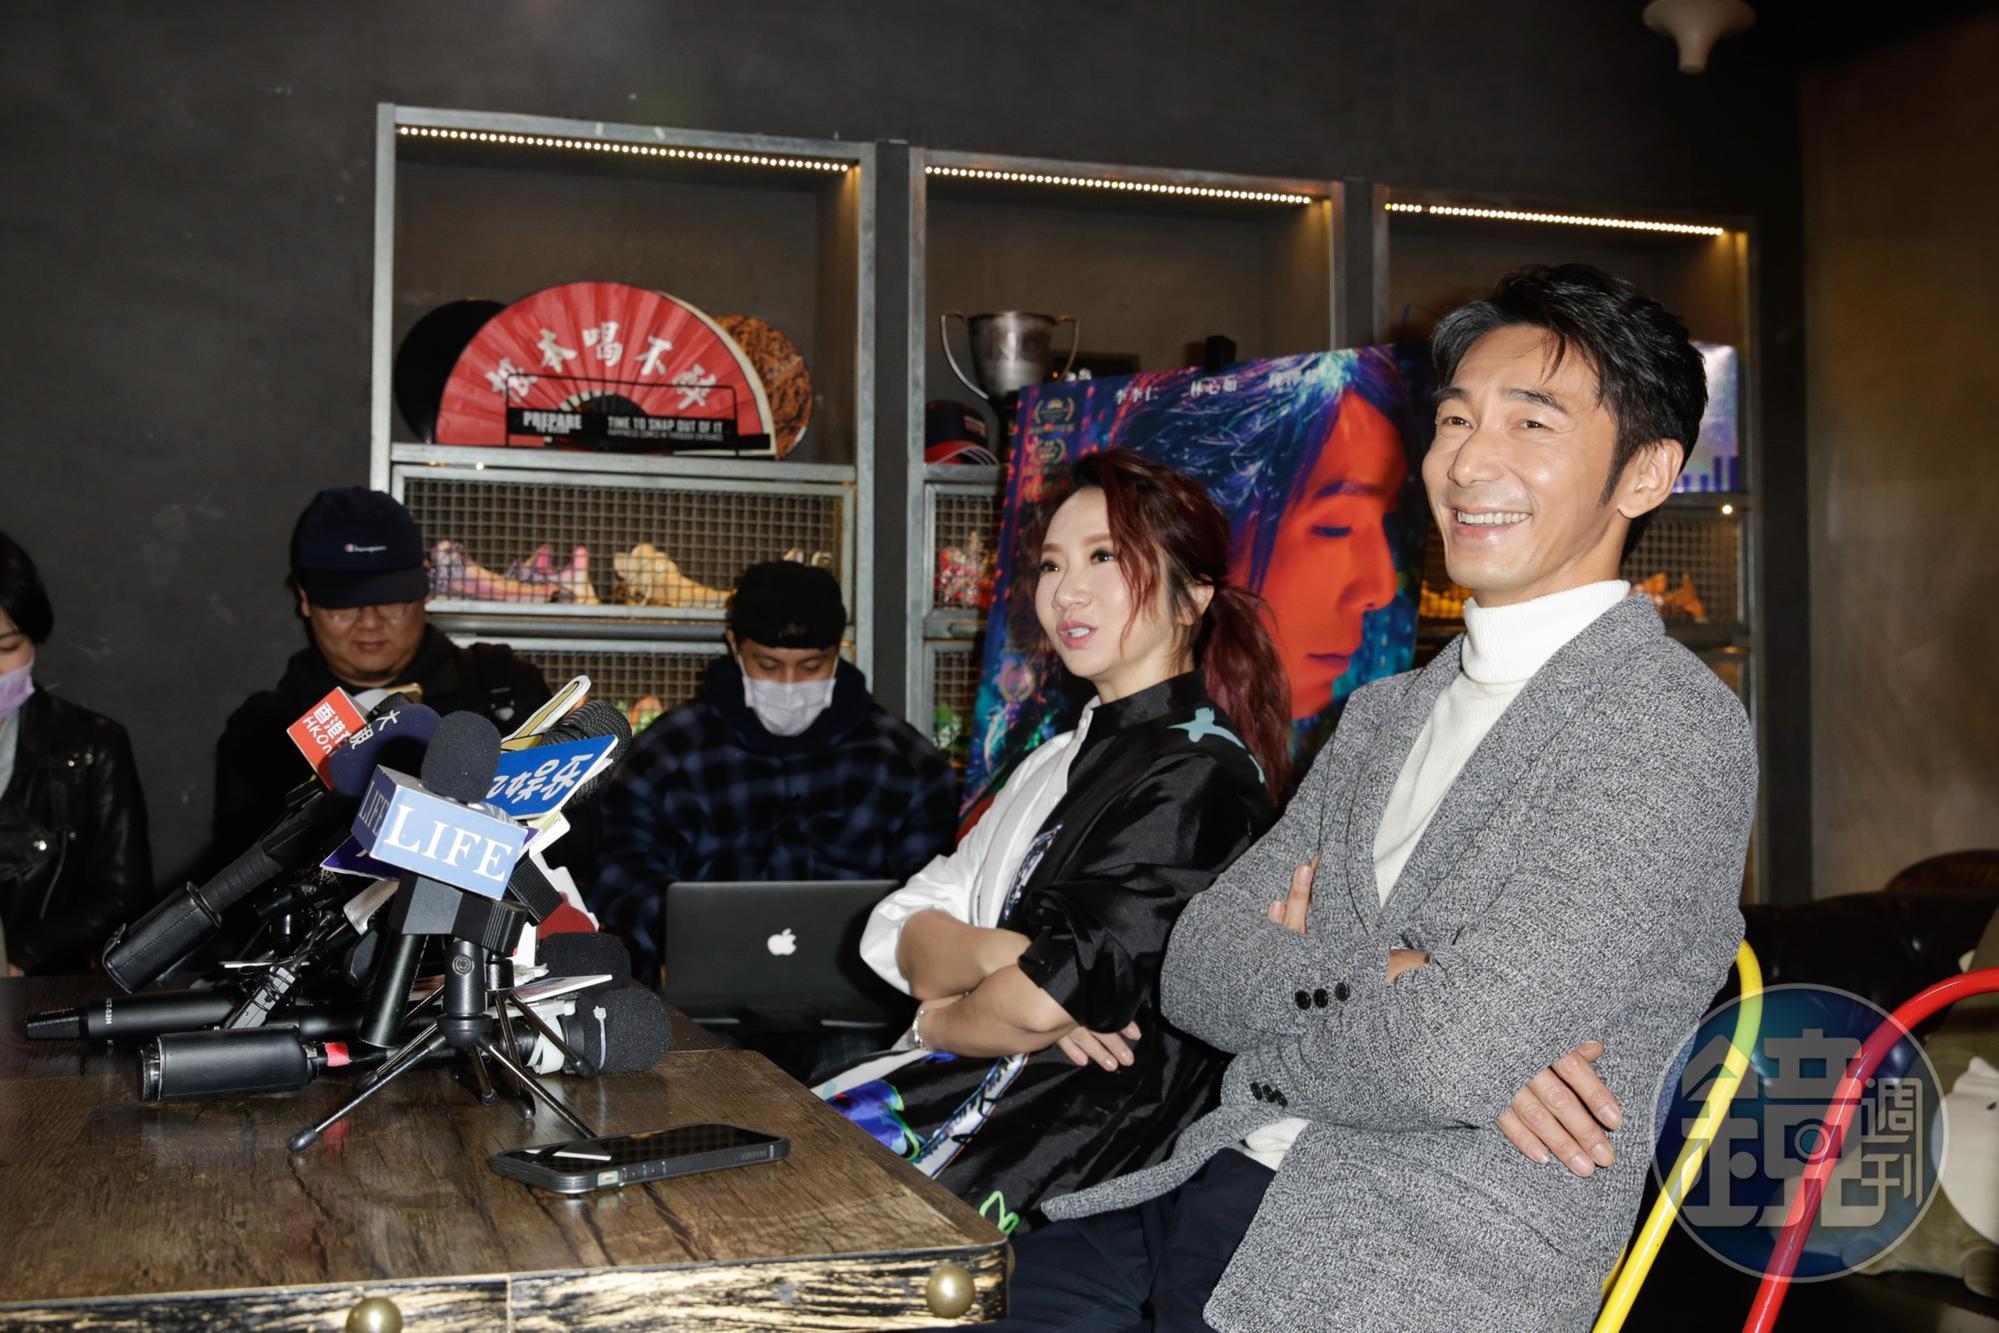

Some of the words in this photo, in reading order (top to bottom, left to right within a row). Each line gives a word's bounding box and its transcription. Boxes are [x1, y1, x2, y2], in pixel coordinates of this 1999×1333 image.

[303, 716, 336, 756] HKOn
[358, 781, 390, 836] LIFE
[383, 803, 513, 882] LIFE
